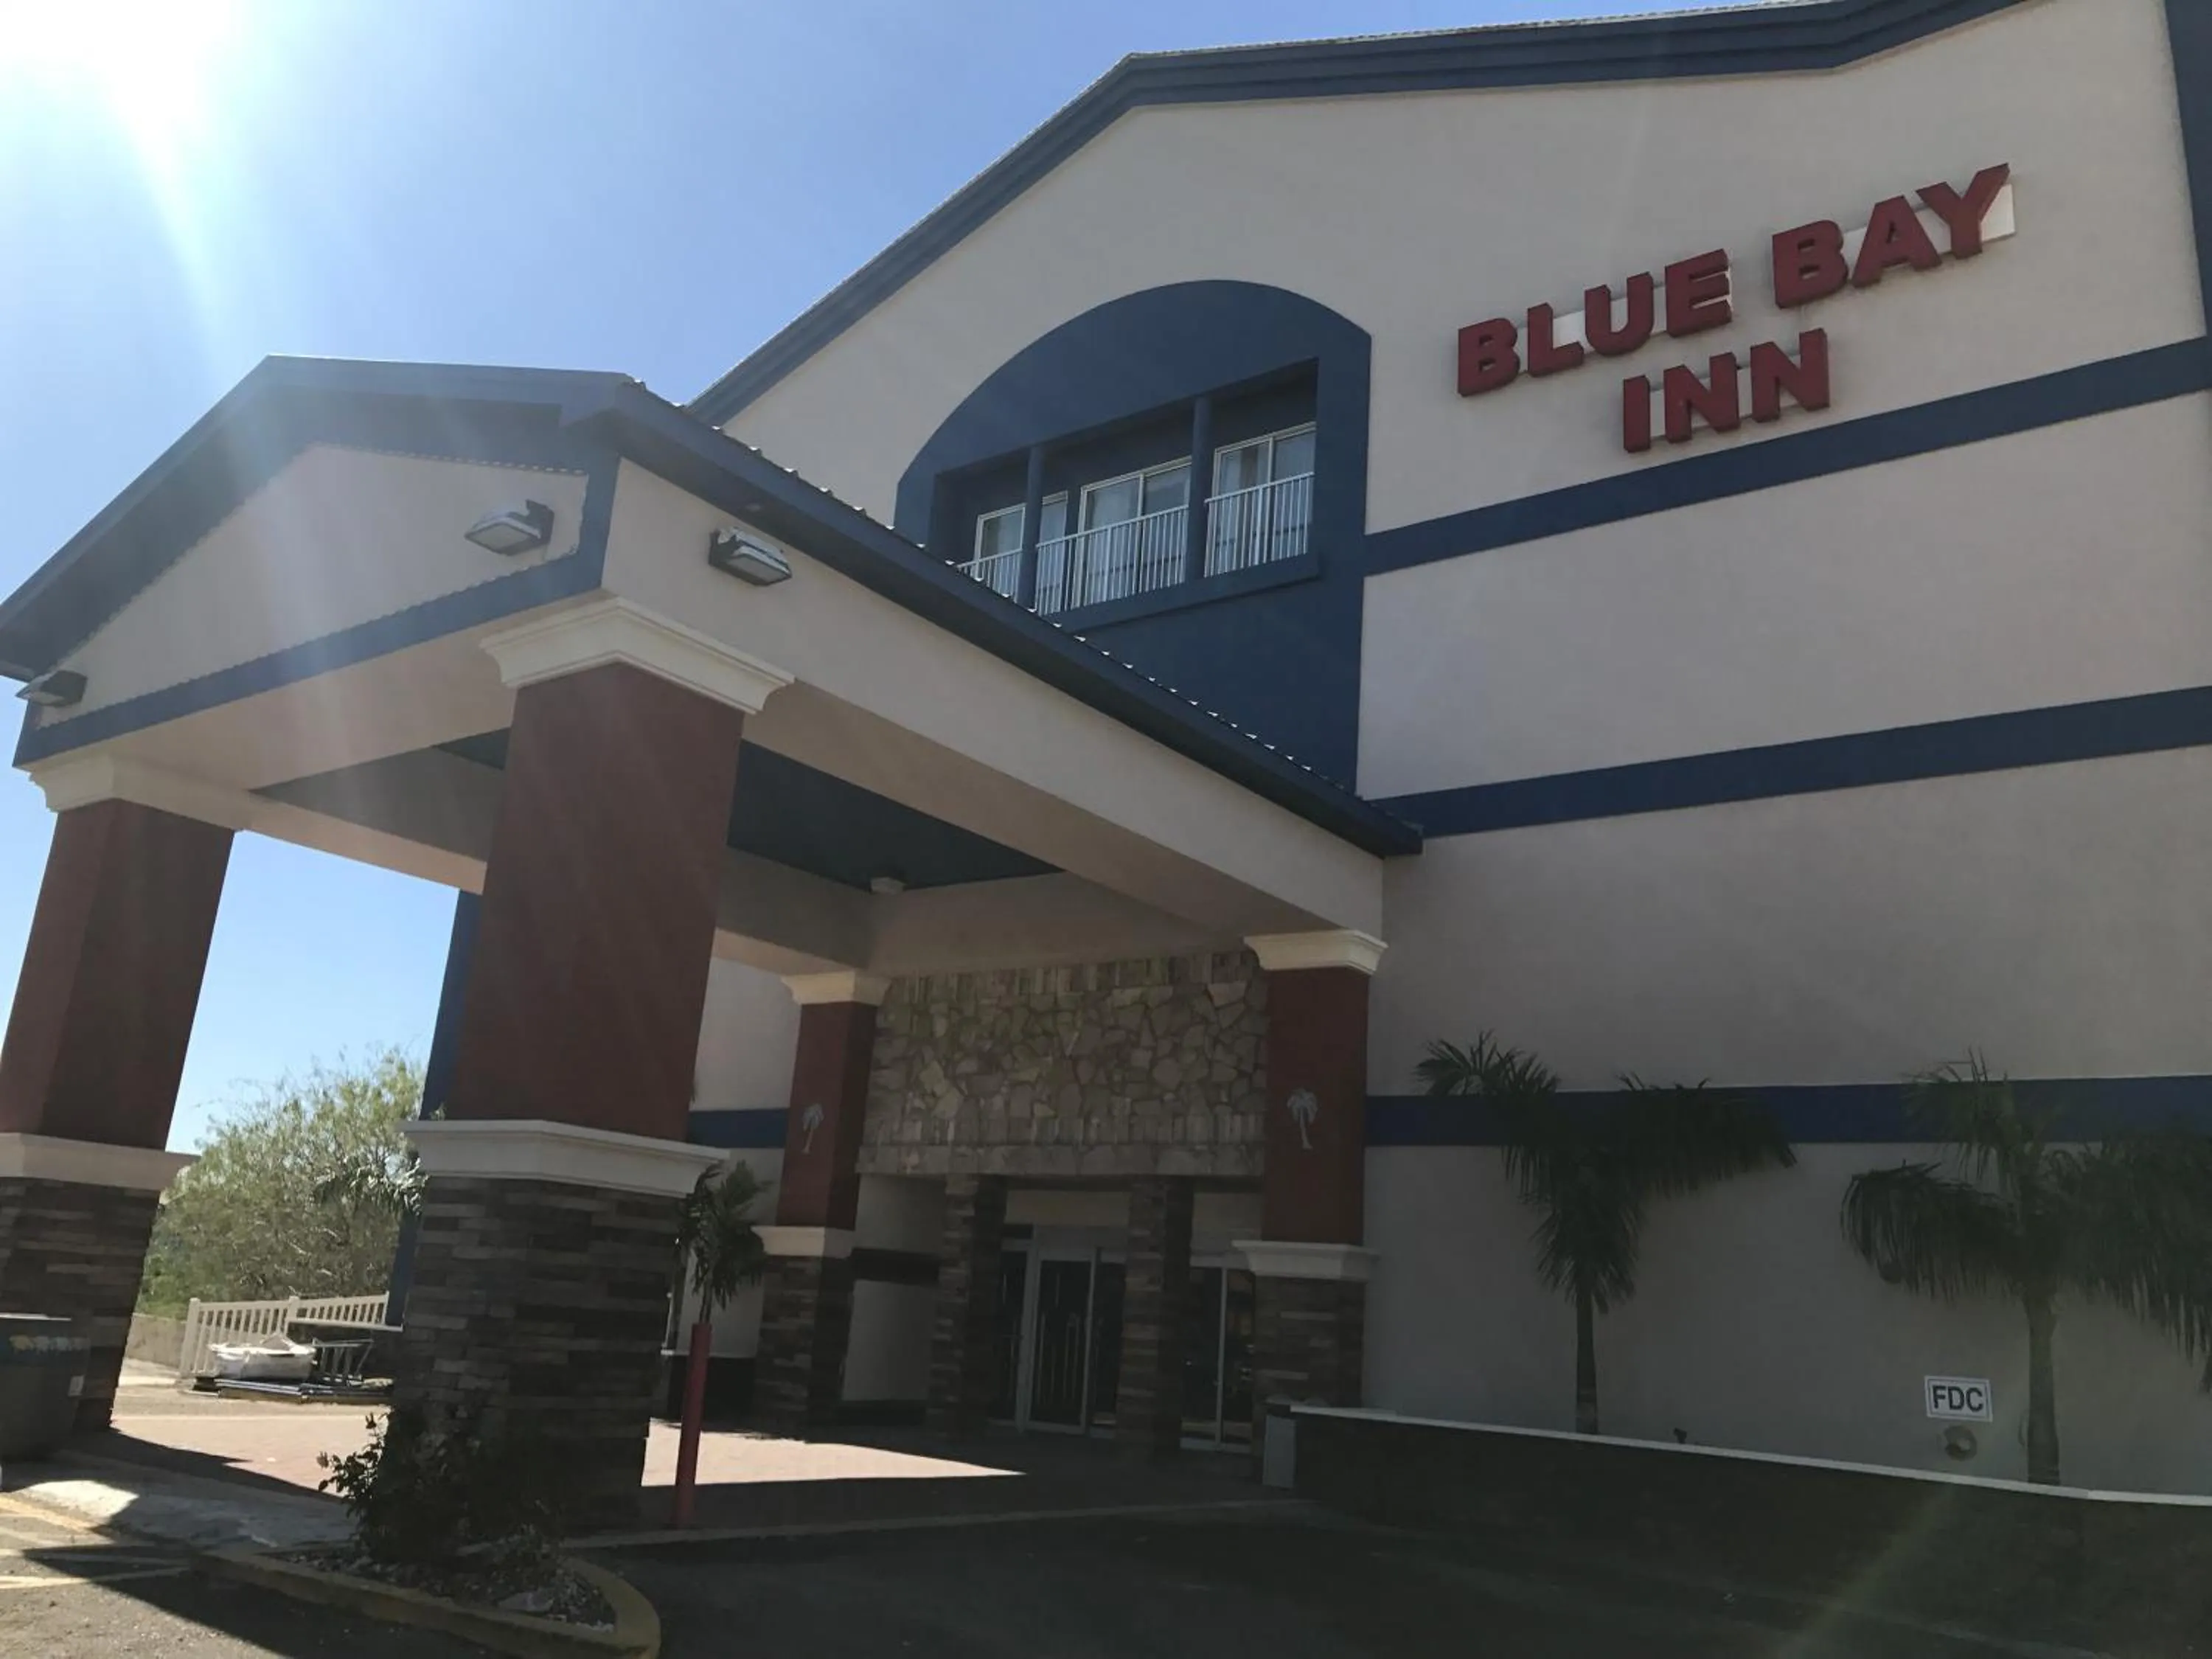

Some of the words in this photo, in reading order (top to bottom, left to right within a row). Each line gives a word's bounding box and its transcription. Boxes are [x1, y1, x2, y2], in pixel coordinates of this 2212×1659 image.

[1458, 248, 1731, 397] BLUE
[1772, 163, 2010, 309] BAY
[1624, 327, 1830, 453] INN
[1932, 1385, 1983, 1413] FDC
